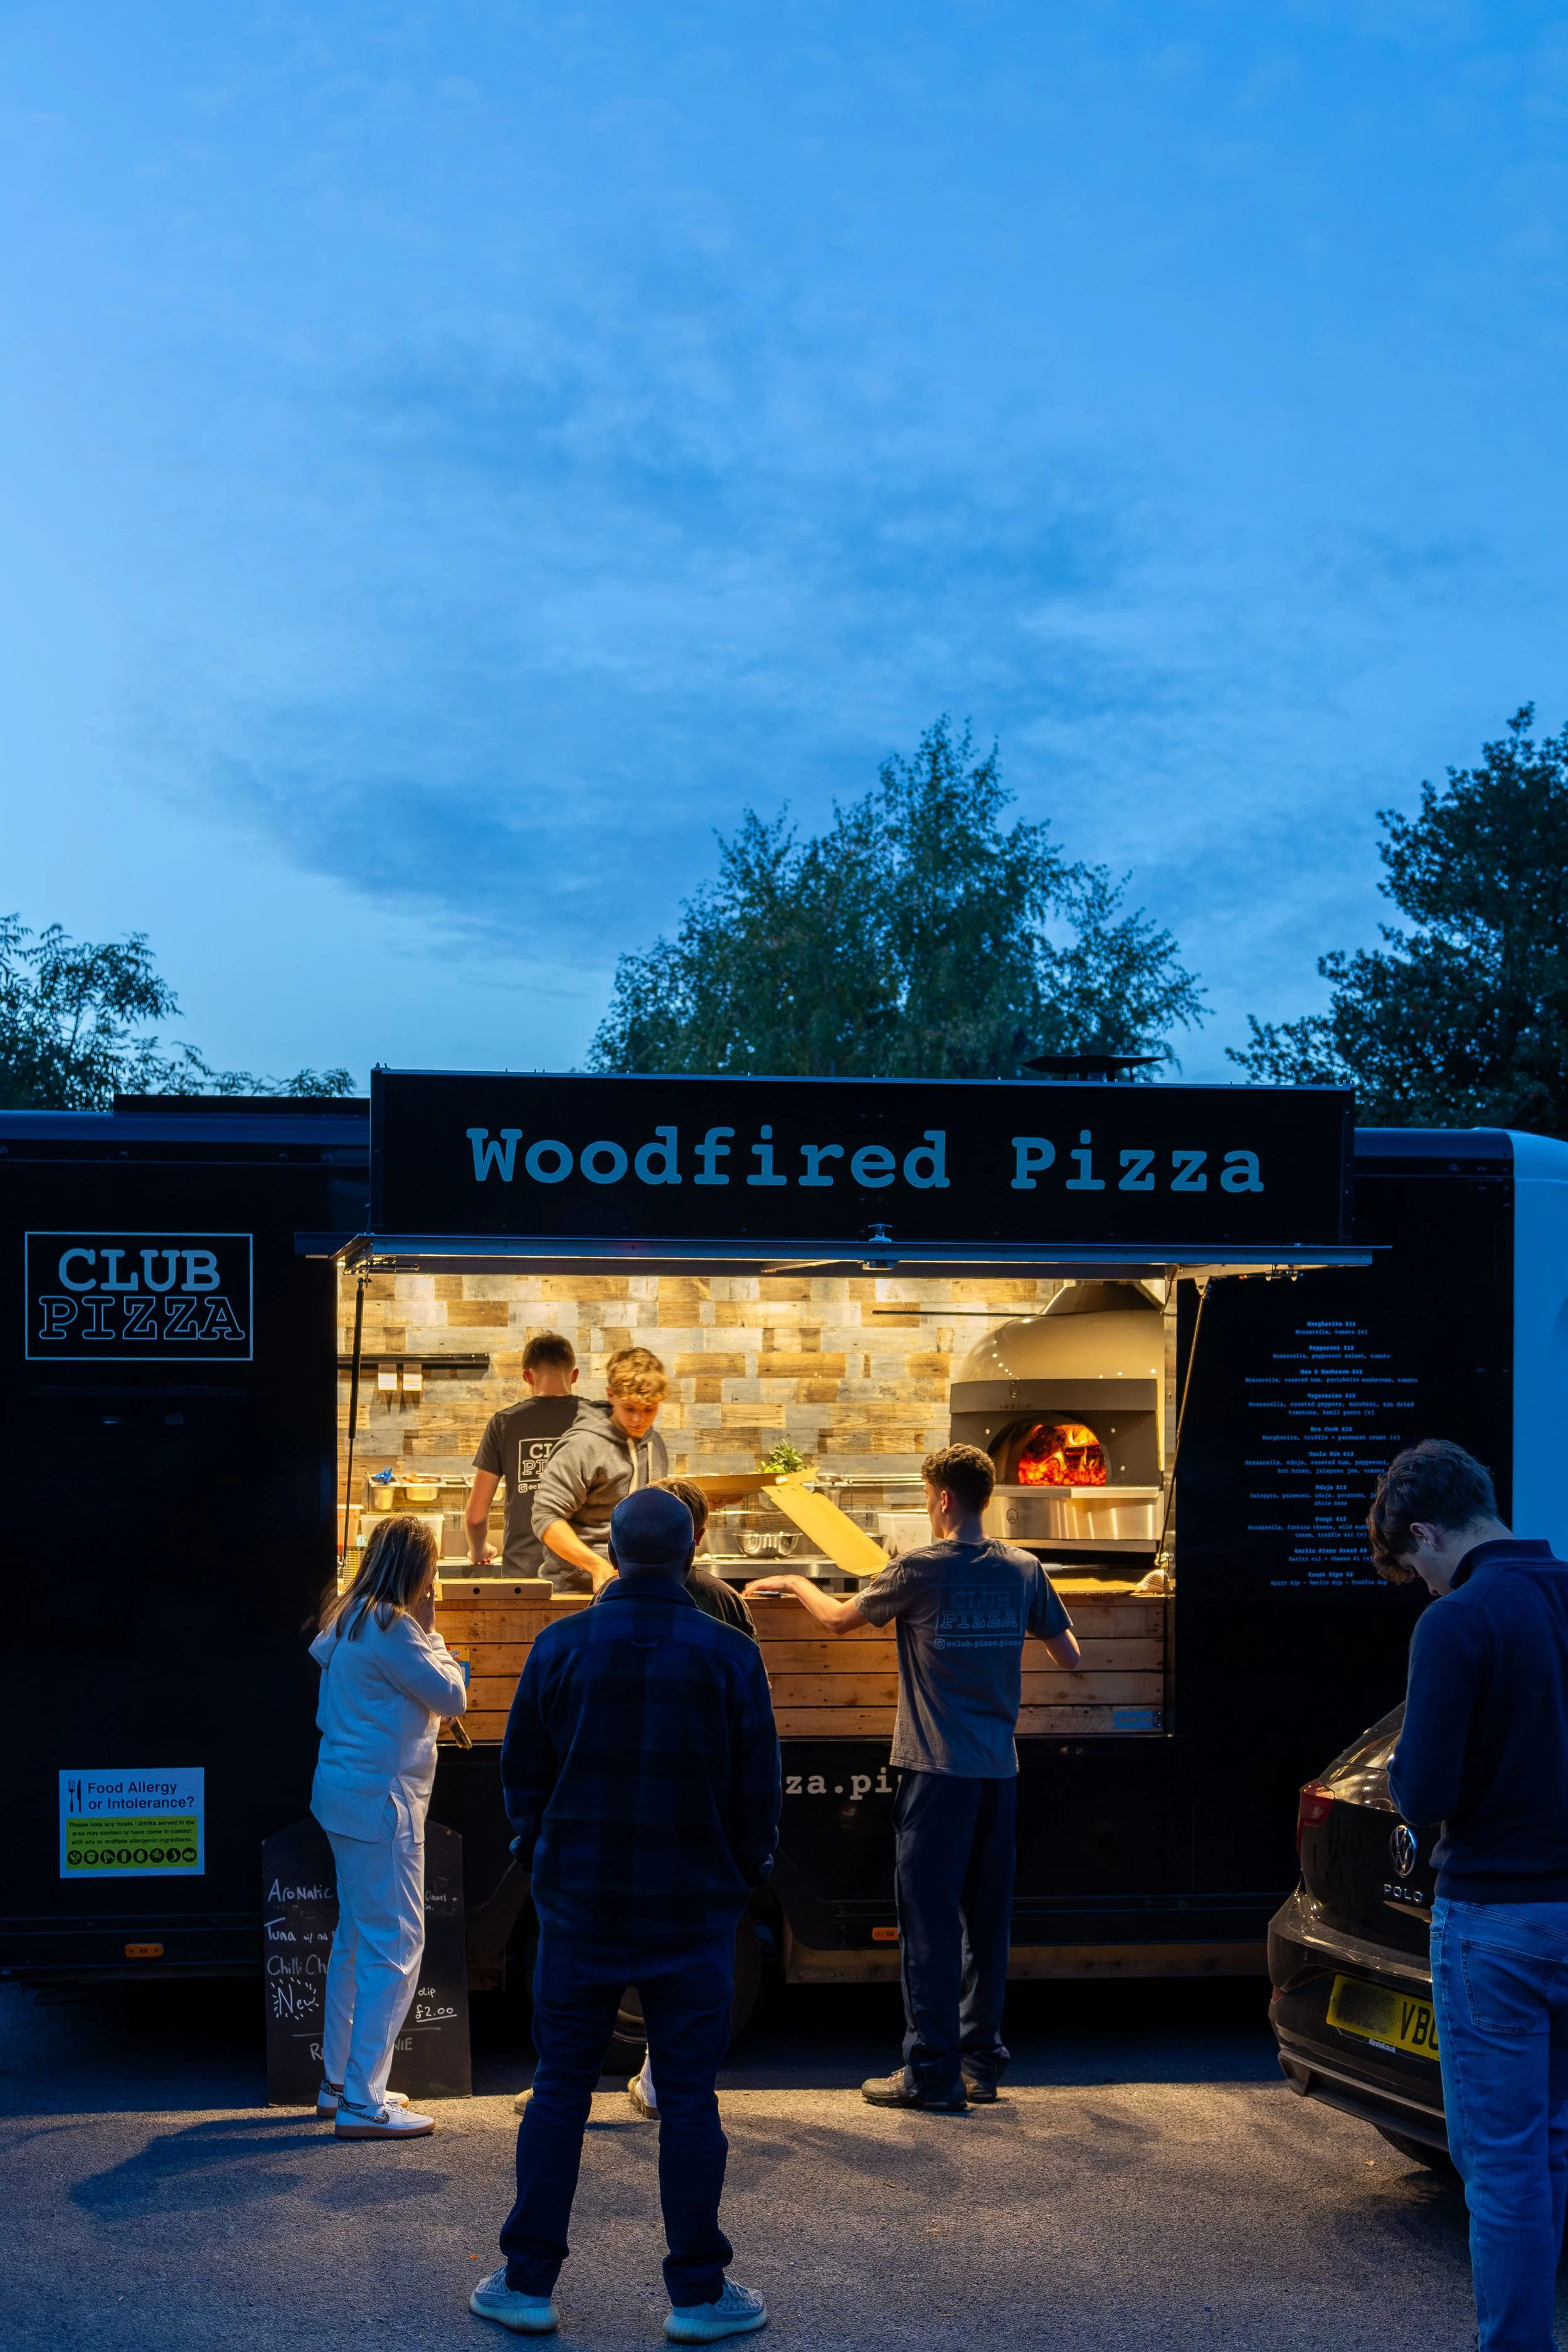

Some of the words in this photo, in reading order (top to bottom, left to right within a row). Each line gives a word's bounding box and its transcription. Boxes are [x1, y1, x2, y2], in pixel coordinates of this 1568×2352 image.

[466, 1125, 950, 1189] Woodfired
[1010, 1130, 1264, 1192] Pizza
[58, 1248, 220, 1292] CLUB
[38, 1296, 245, 1340] PIZZA
[951, 1590, 1011, 1609] CLUB
[940, 1608, 1019, 1629] PIZZA
[88, 1782, 124, 1794] Food
[128, 1781, 177, 1796] Allergy
[88, 1800, 103, 1810] or
[107, 1796, 195, 1810] Intolerance?
[1384, 1883, 1422, 1903] POLO
[264, 1917, 296, 1941] Tuna
[267, 1955, 303, 1976] Chilli
[277, 1984, 316, 2015] New
[418, 1986, 436, 1999] dip
[415, 2005, 454, 2020] £2.00
